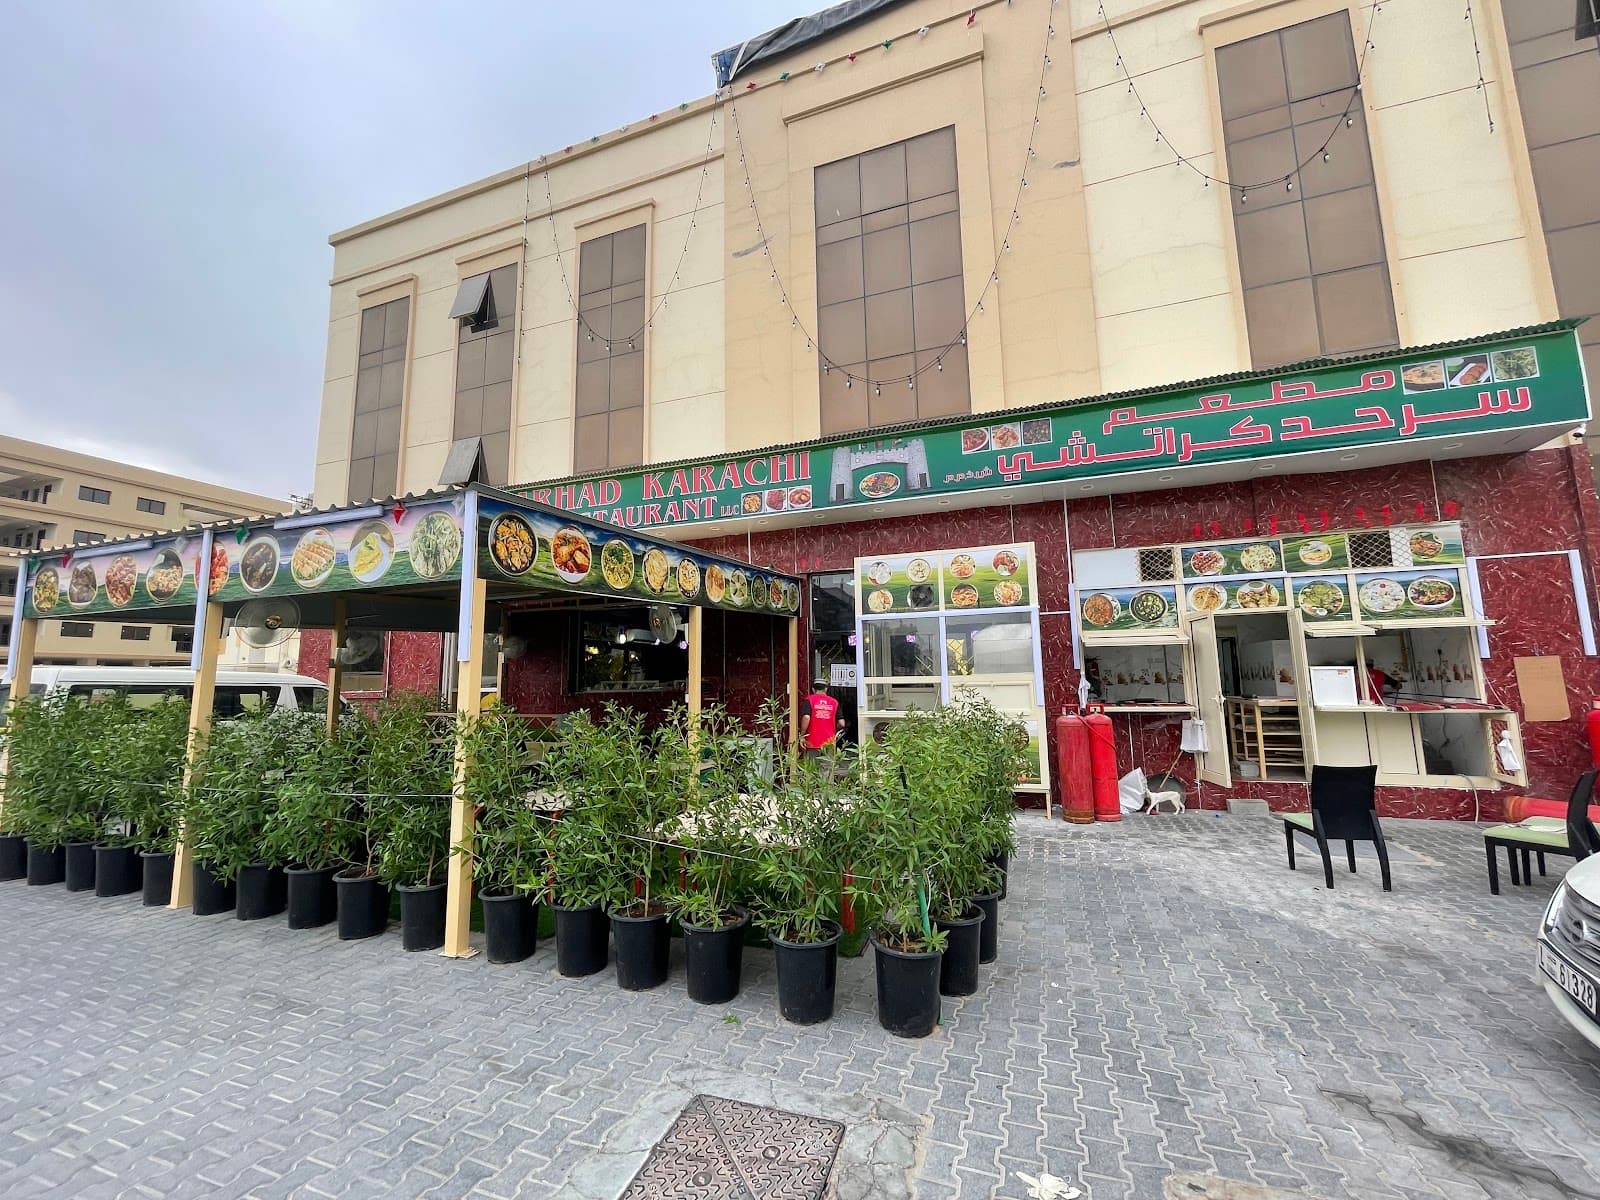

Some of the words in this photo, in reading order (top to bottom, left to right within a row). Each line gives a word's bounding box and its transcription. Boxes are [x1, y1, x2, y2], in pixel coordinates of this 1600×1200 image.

[1102, 369, 1395, 434] مطعم
[518, 479, 622, 510] RHAD
[642, 450, 811, 501] KARACHI
[580, 496, 718, 529] TAURANT
[720, 504, 740, 517] LLC
[745, 1166, 763, 1188] D400
